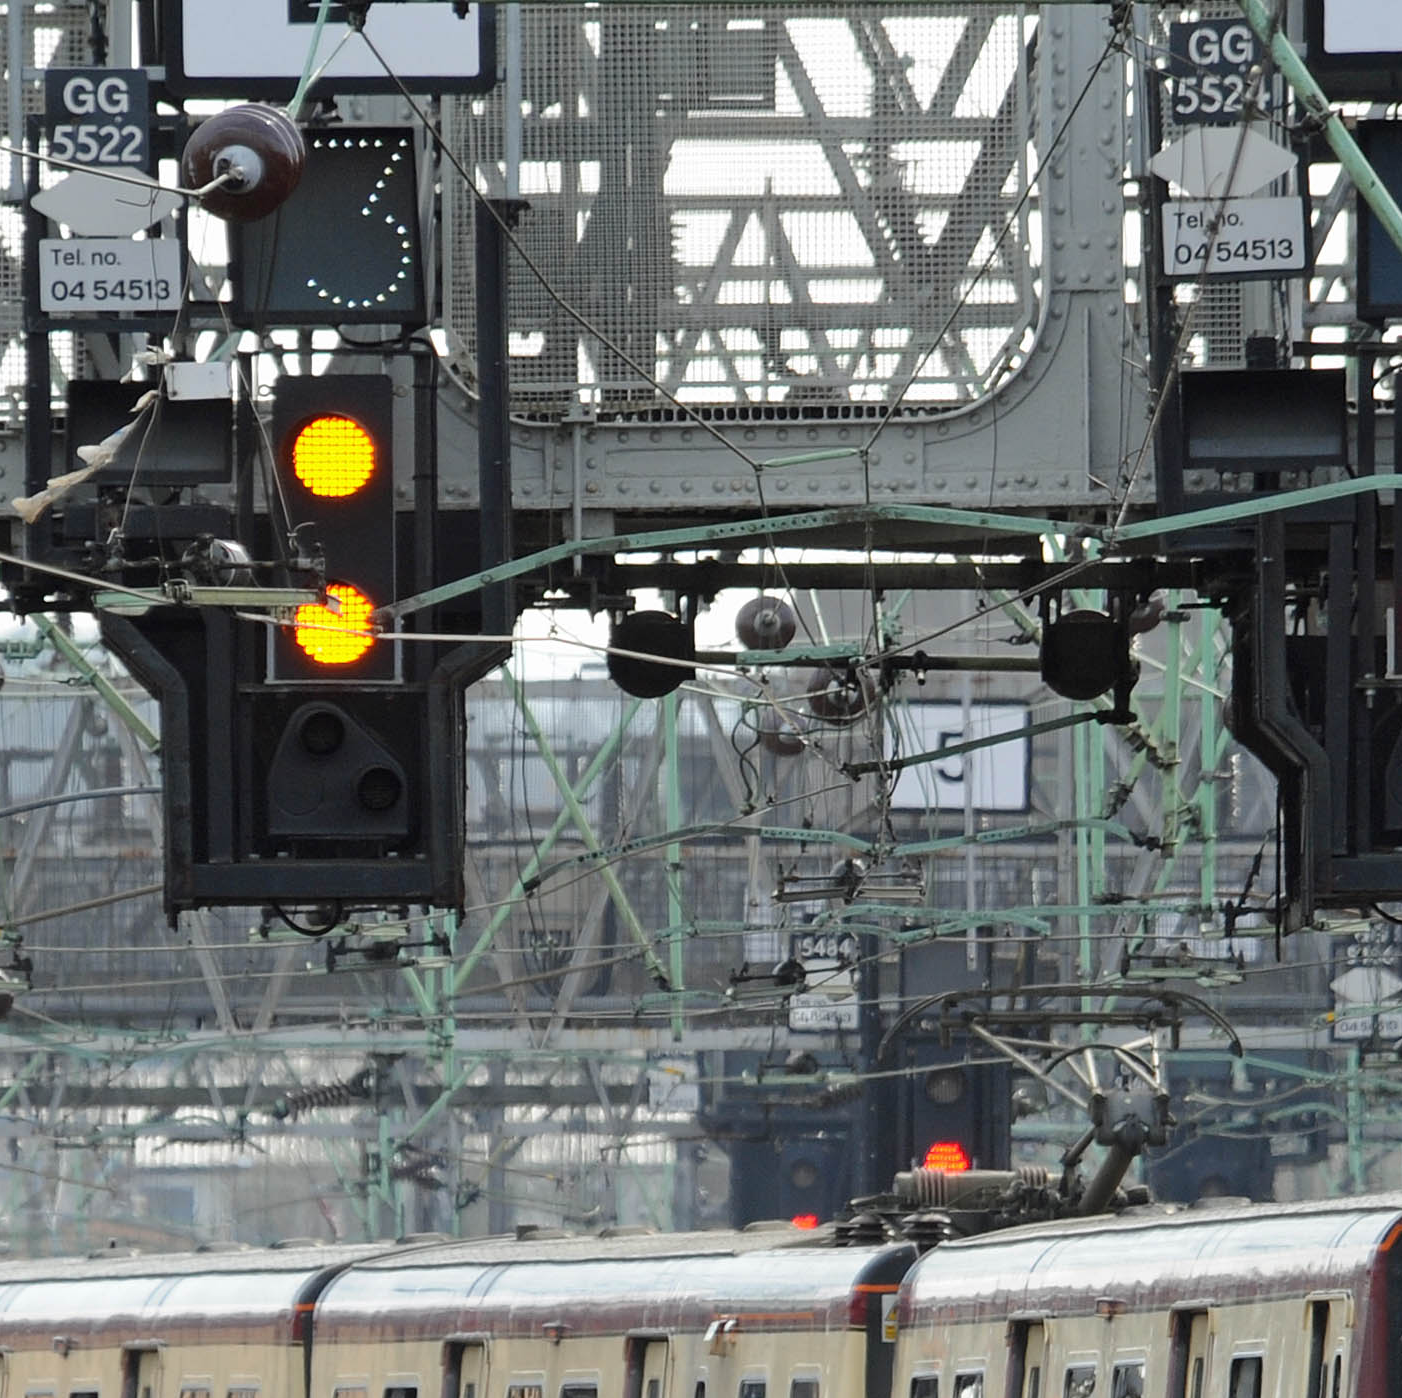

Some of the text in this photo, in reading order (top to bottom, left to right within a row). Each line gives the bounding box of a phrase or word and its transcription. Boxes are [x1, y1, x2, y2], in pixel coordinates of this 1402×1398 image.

[1188, 25, 1253, 65] GG
[63, 77, 129, 115] GG
[50, 125, 143, 163] 5522
[51, 249, 121, 266] Tel. no.
[1217, 239, 1294, 262] 54513
[51, 280, 170, 302] 04 54513
